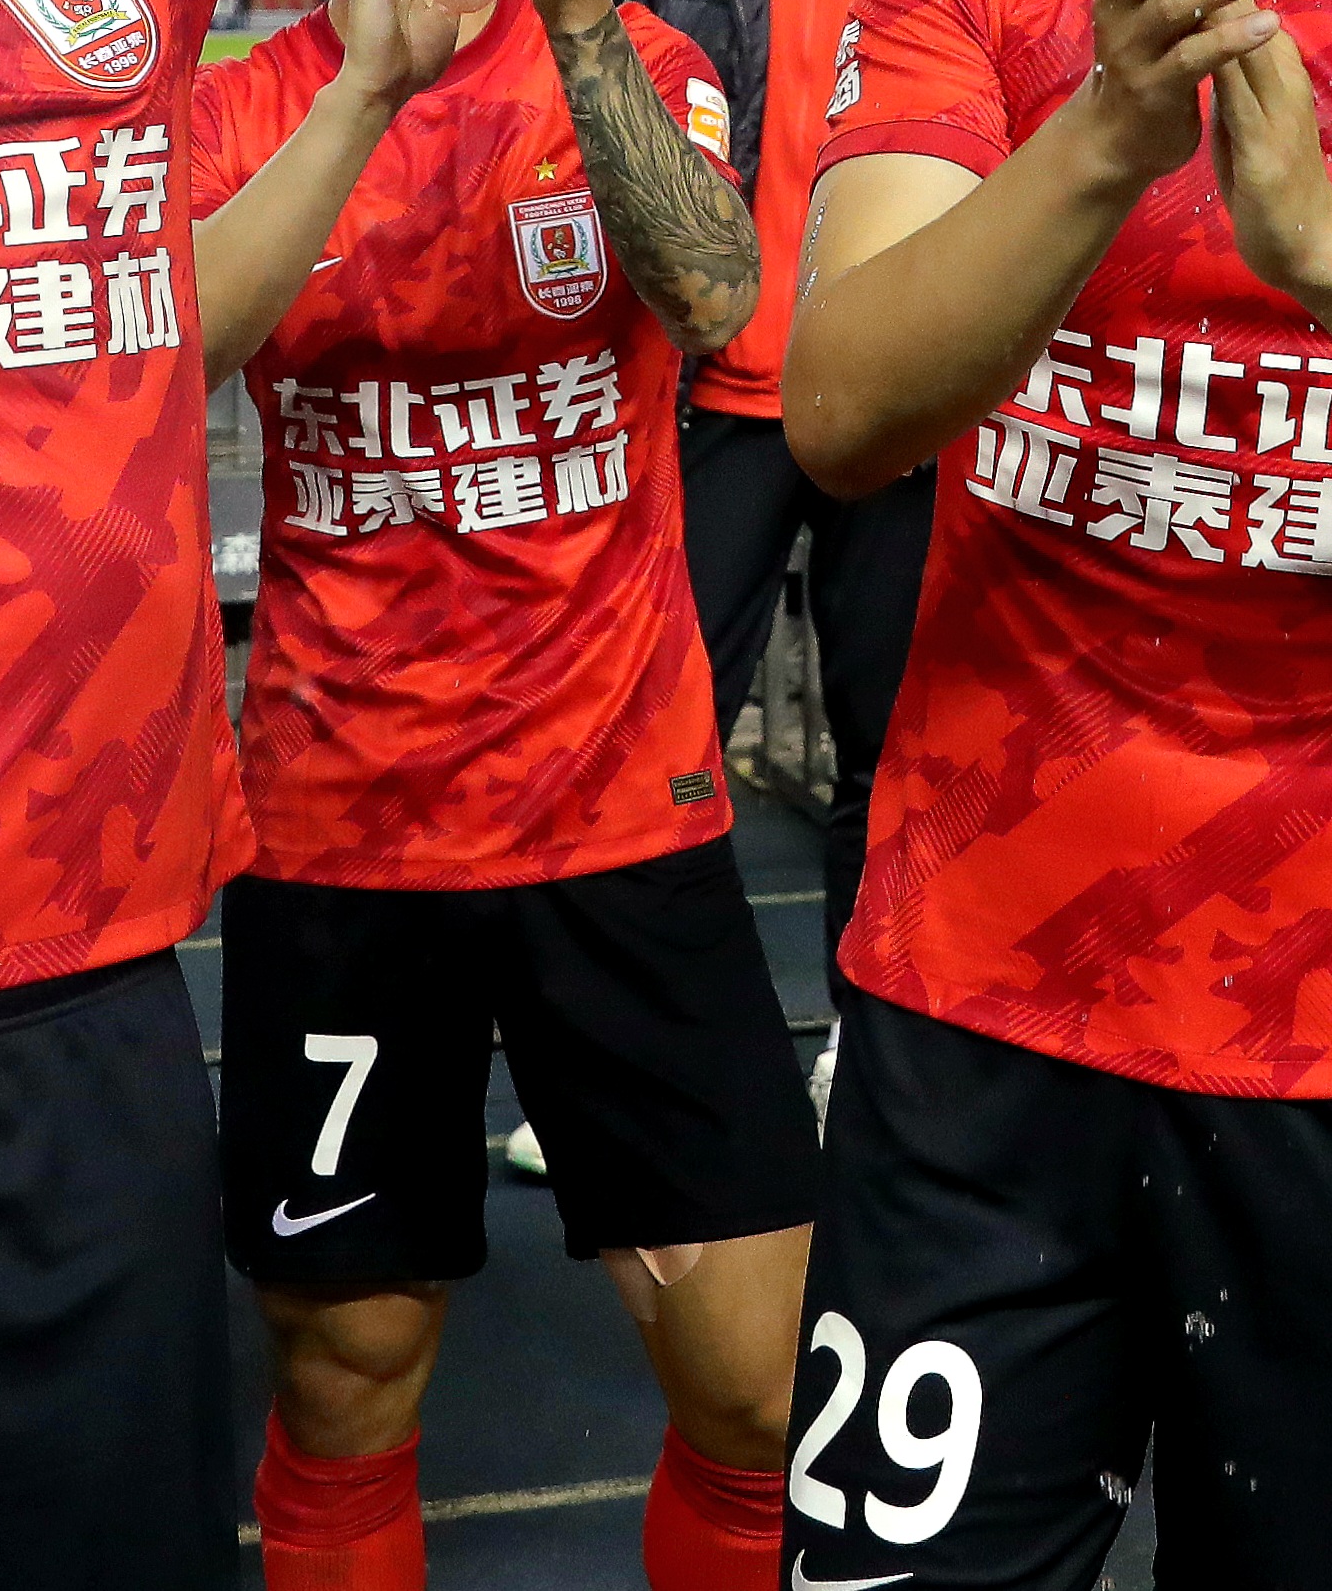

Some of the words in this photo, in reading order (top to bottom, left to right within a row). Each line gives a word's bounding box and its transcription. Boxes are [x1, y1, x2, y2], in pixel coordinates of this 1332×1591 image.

[77, 30, 146, 70] 长春亚泰
[102, 53, 139, 75] 1996
[272, 347, 622, 459] 东北证券
[283, 428, 629, 537] 亚泰建材
[303, 1033, 378, 1176] 7
[789, 1311, 983, 1545] 29
